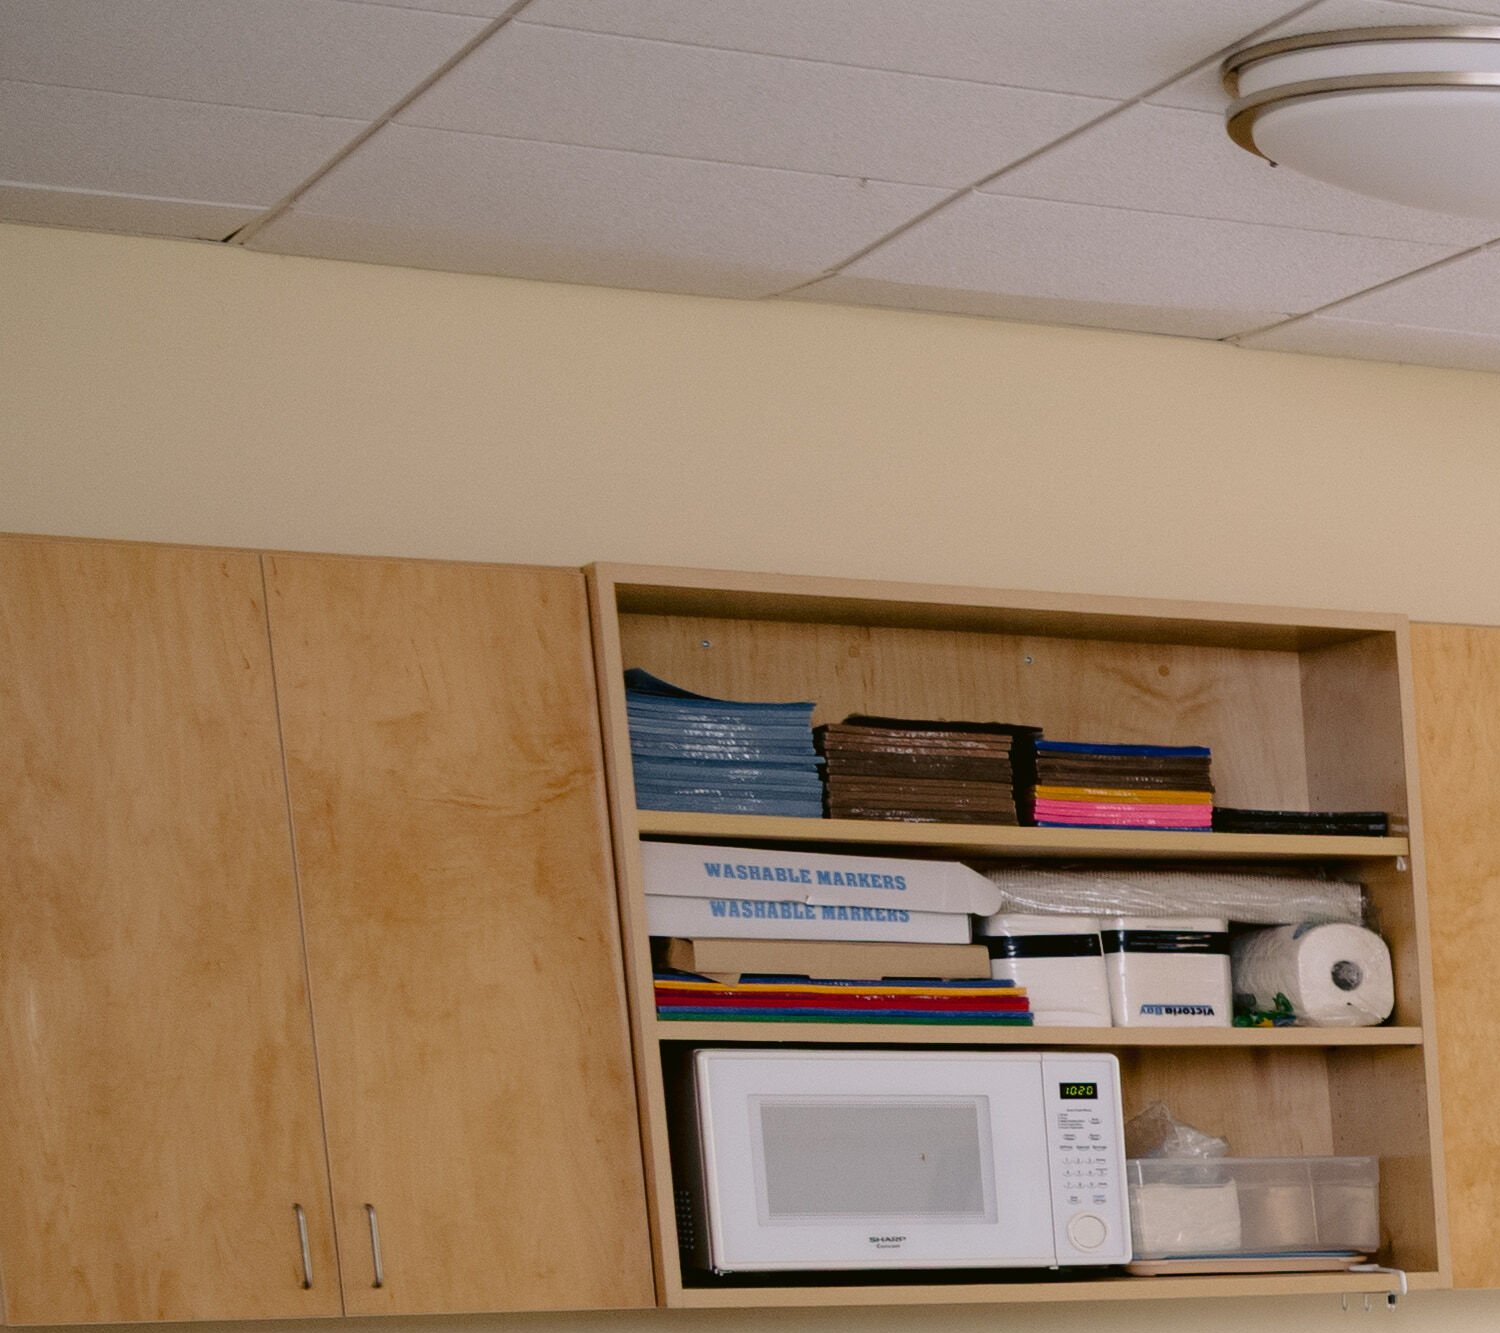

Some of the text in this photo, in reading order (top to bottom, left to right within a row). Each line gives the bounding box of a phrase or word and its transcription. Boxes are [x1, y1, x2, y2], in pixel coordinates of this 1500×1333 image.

[703, 862, 907, 891] WASHABLE MARKERS
[710, 899, 911, 923] WASHABLE MARKERS
[1140, 1004, 1215, 1016] Victoria Bay
